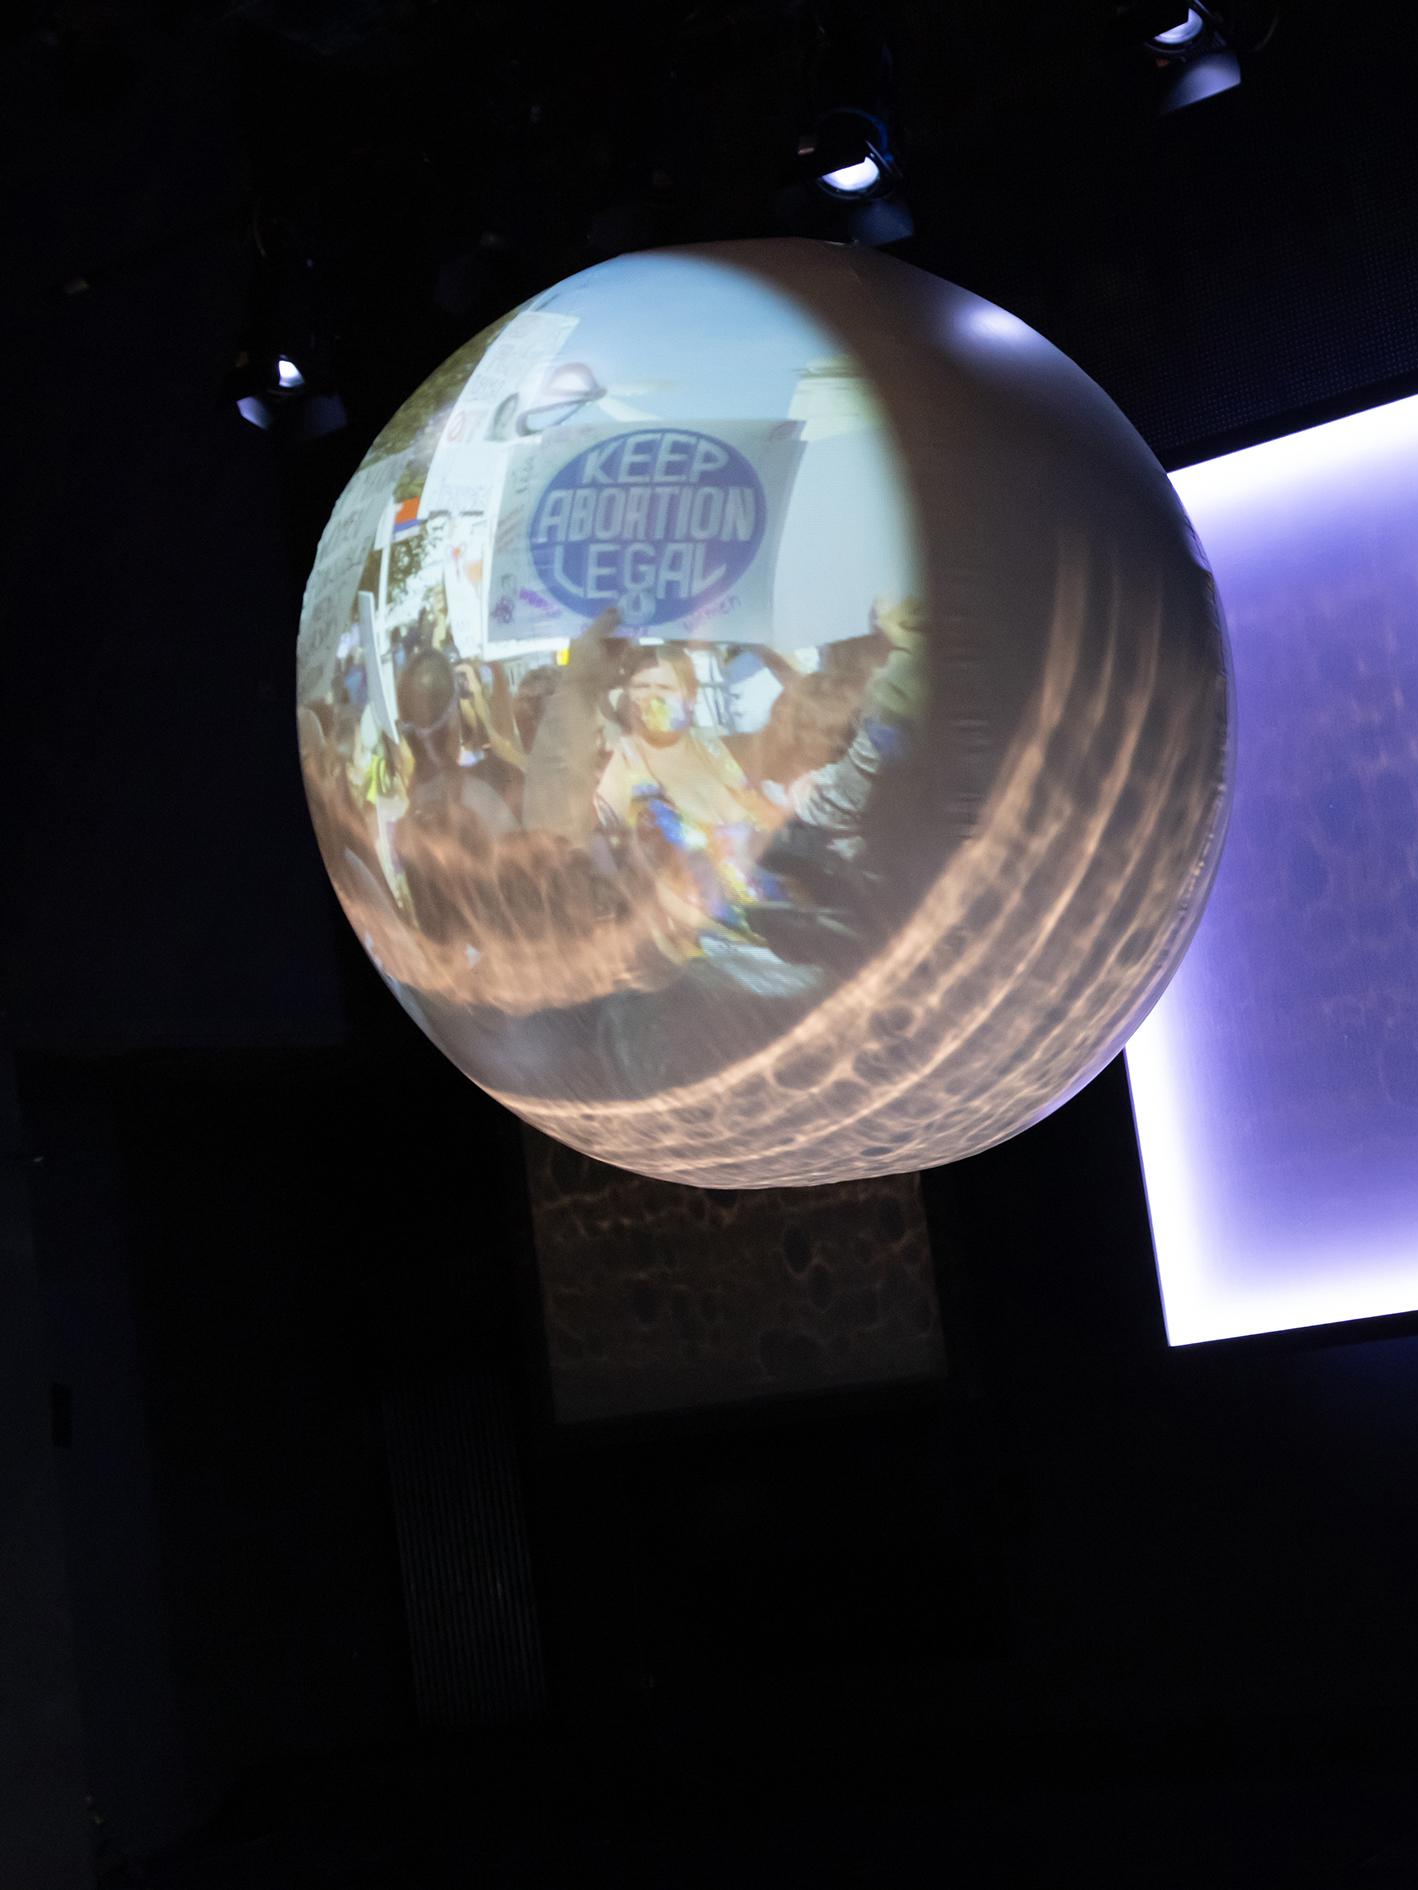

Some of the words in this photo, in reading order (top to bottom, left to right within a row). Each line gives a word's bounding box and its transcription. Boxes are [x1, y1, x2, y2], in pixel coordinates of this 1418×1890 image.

[582, 433, 730, 484] KEEP
[533, 486, 757, 543] ABORTION
[553, 543, 727, 600] LEGAL
